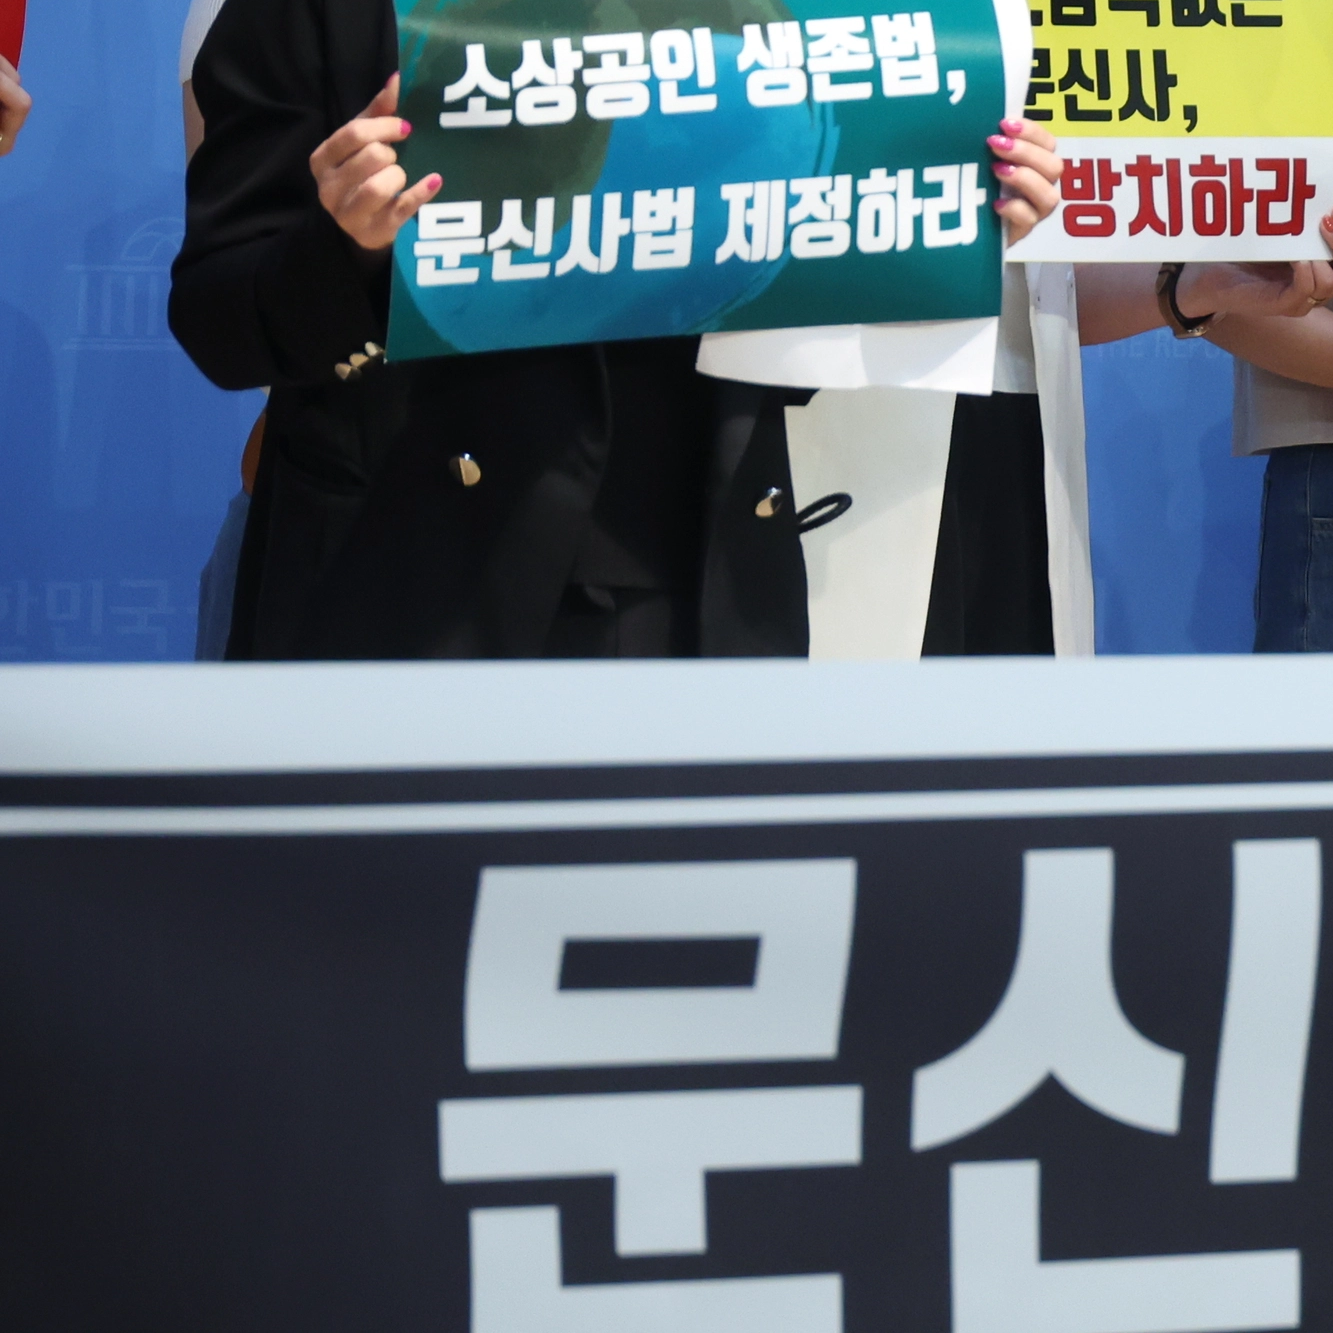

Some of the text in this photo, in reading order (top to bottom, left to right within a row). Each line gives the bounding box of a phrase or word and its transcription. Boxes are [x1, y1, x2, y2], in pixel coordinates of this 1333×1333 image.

[439, 12, 968, 128] 소상공인 생존법,
[413, 163, 987, 286] 문신사법 제정하라
[1061, 154, 1316, 237] 방치하라
